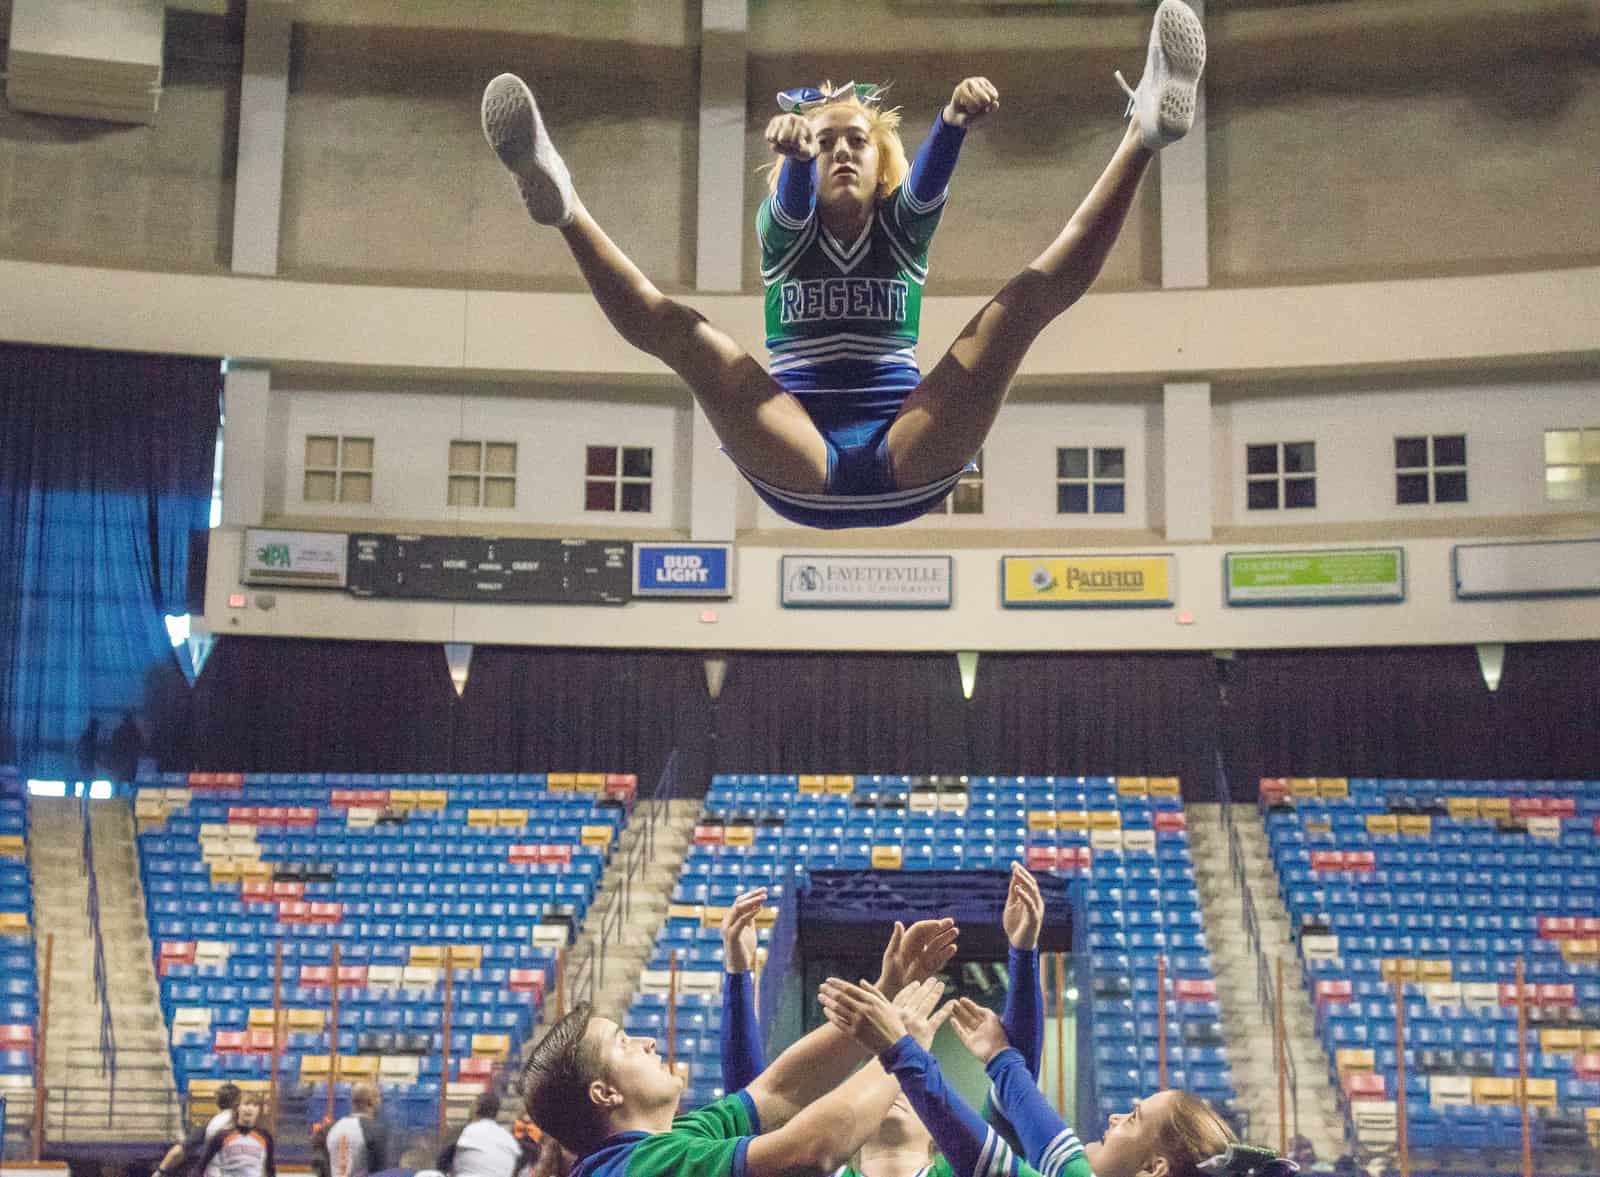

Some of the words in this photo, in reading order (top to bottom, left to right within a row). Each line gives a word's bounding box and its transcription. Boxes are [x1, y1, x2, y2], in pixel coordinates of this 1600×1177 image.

[780, 277, 909, 324] REGENT
[663, 554, 703, 569] BUD
[655, 567, 709, 583] LIGHT
[826, 564, 945, 581] FAYETTEVILLE
